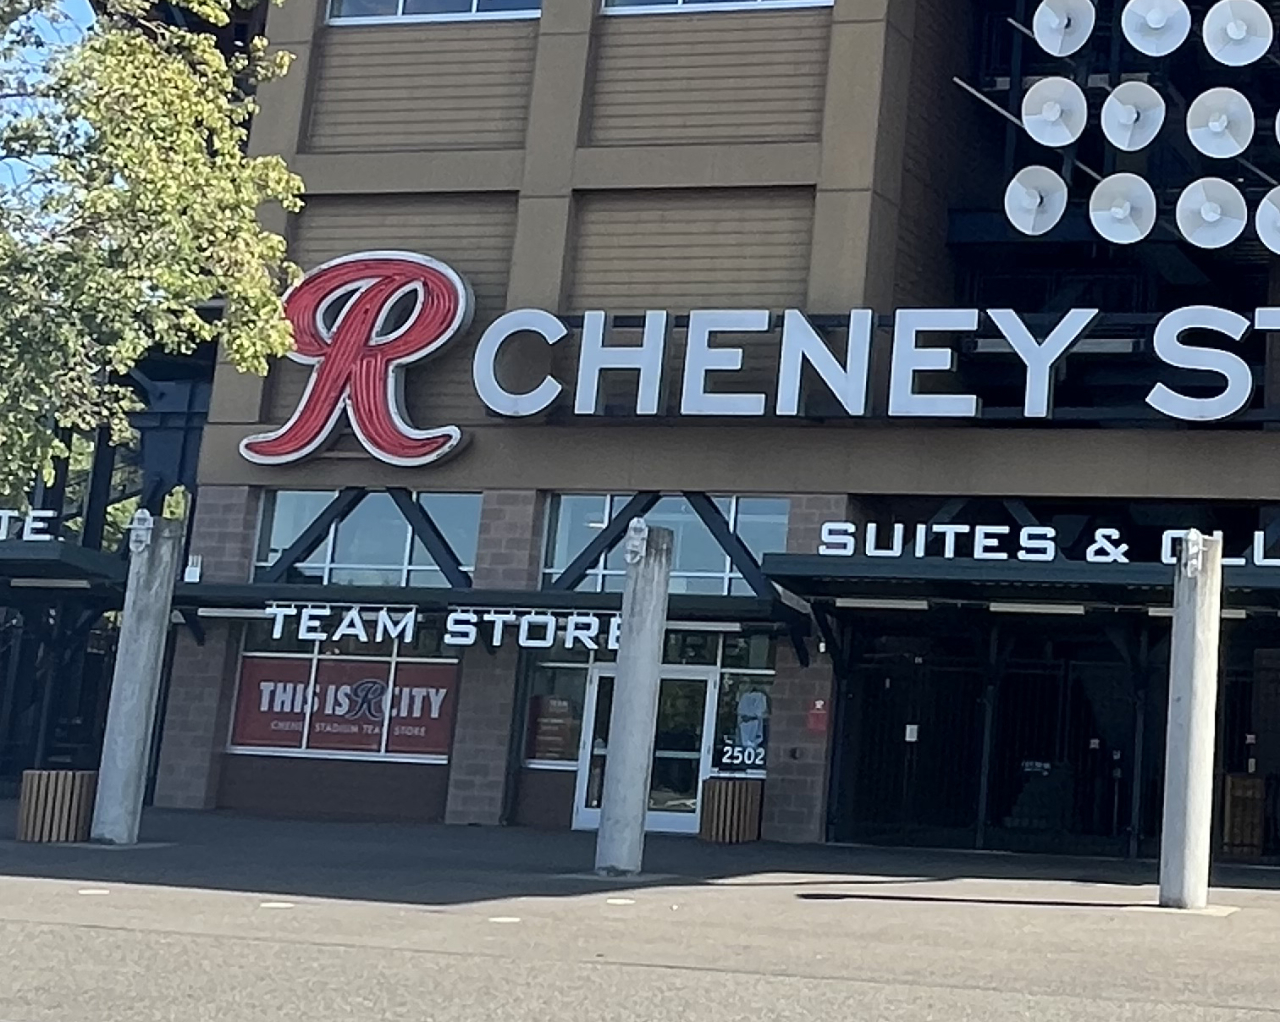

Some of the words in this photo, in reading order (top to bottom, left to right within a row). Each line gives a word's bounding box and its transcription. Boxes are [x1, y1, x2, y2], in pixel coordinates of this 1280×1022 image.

[238, 250, 471, 467] R
[472, 308, 1100, 418] CHENEY
[818, 521, 1056, 561] SUITES
[1086, 528, 1129, 563] &
[264, 607, 416, 642] TEAM
[324, 684, 350, 716] IS
[271, 720, 307, 732] CHENE
[362, 724, 389, 736] TEA
[721, 746, 766, 765] 2502
